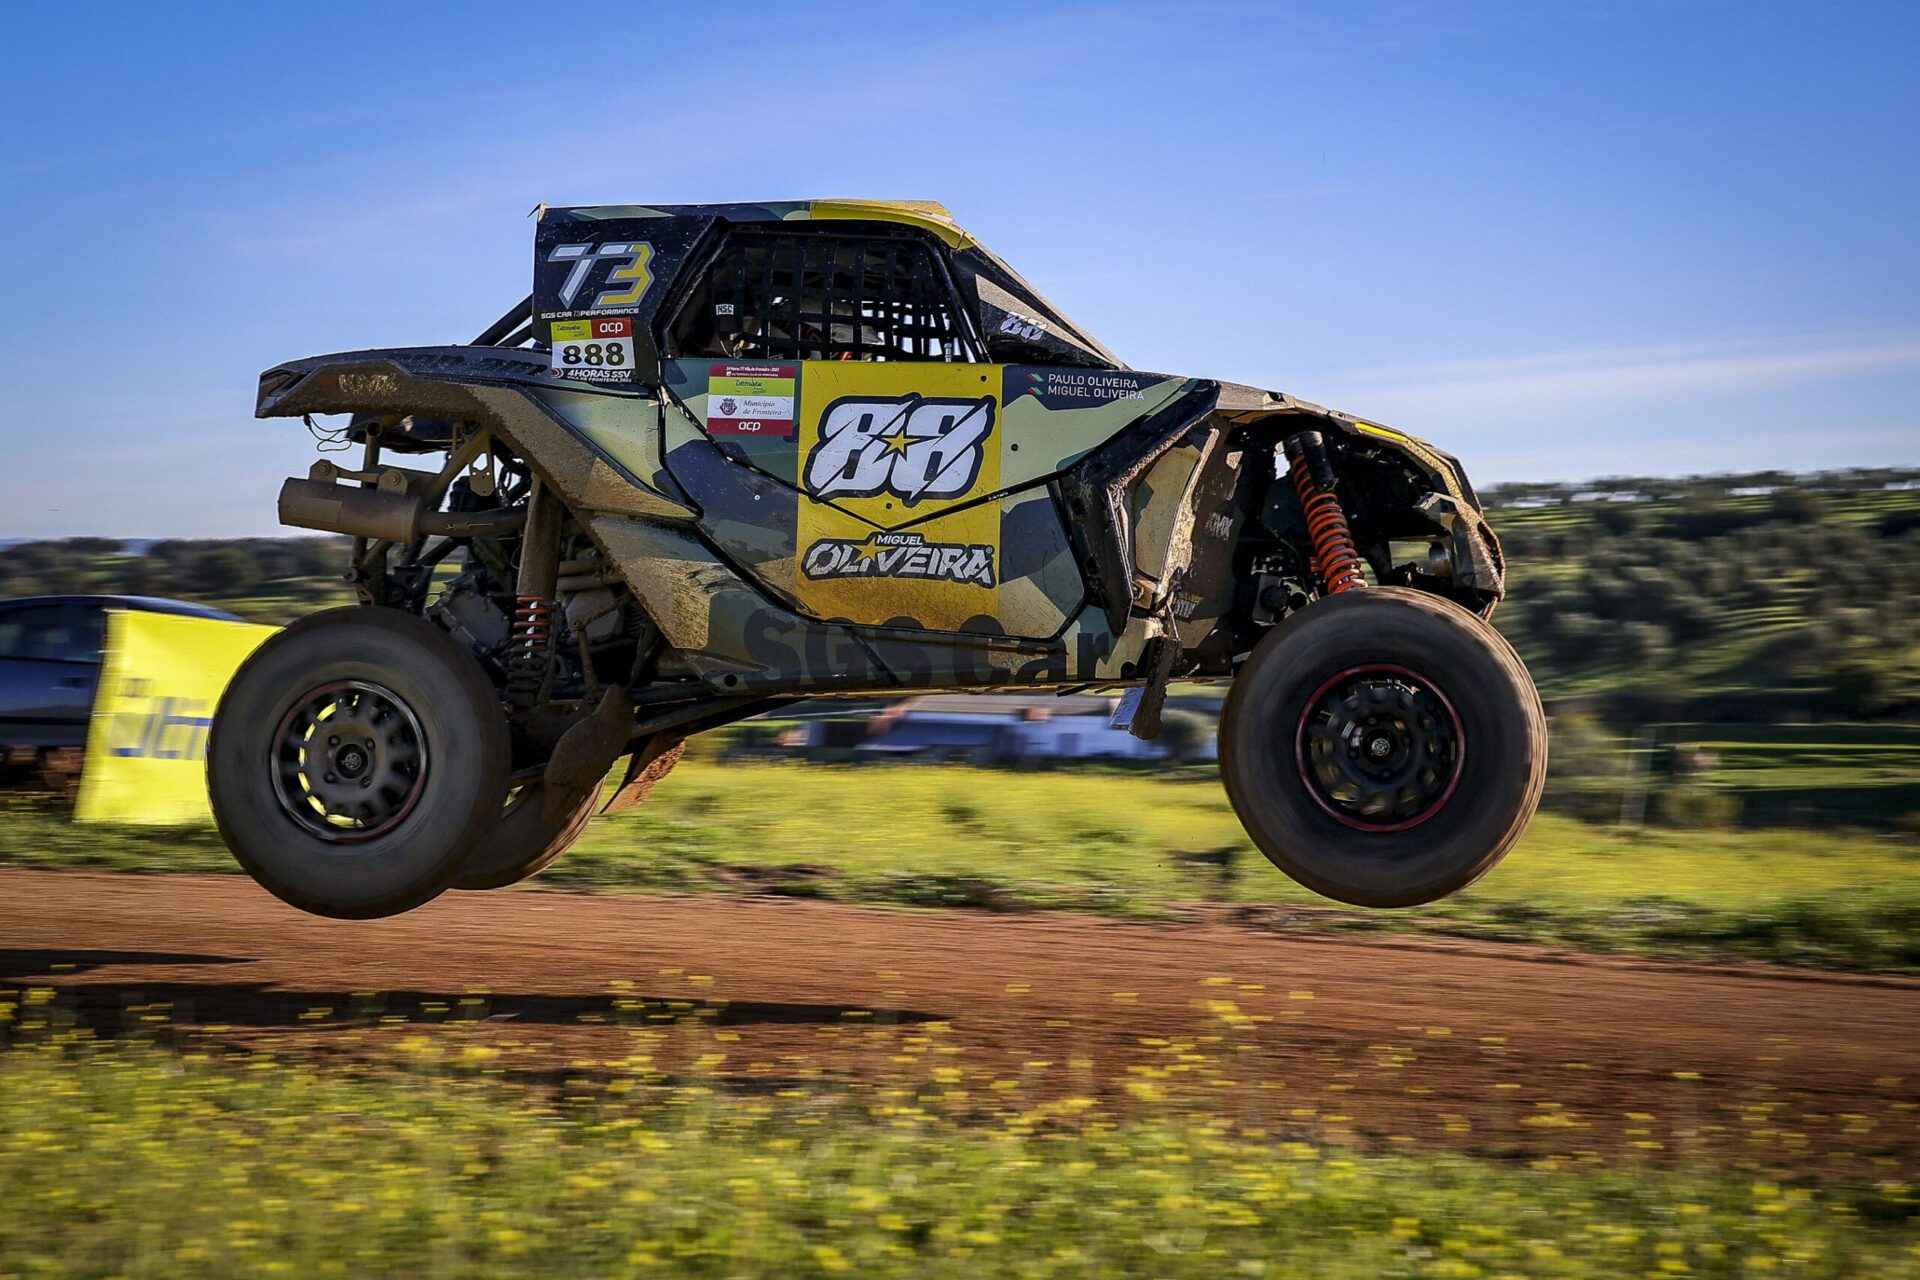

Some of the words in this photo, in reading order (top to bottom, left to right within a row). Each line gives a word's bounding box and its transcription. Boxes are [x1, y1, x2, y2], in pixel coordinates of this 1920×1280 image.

[540, 311, 556, 319] SGS
[557, 310, 572, 318] CAR
[600, 322, 624, 334] acp
[562, 342, 625, 366] 888
[611, 370, 632, 378] SSV
[1048, 373, 1085, 386] PAULO
[1087, 376, 1139, 389] OLIVEIRA
[1047, 385, 1091, 398] MIGUEL
[1093, 387, 1145, 401] OLIVEIRA
[738, 422, 761, 432] acp
[808, 397, 991, 502] 88
[876, 534, 923, 546] MIGUEL
[805, 542, 992, 584] OLIVEIRA
[743, 608, 932, 687] SGS
